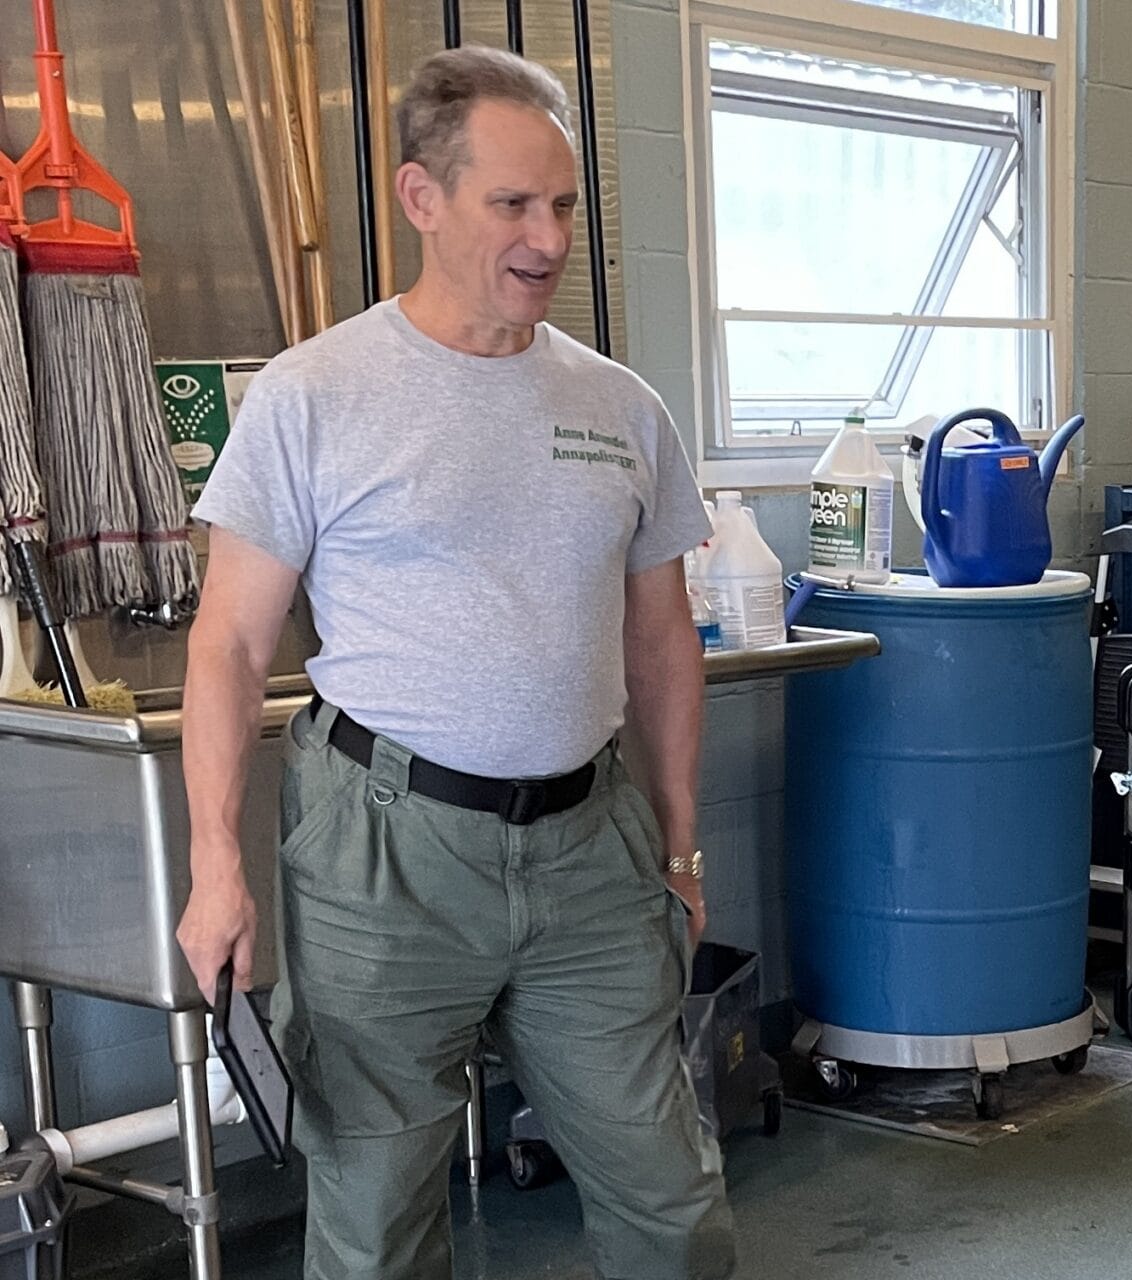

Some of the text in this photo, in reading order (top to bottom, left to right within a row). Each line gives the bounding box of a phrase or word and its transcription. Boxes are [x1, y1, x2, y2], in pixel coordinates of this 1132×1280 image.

[554, 425, 586, 441] Anne
[552, 446, 615, 465] Annapolis
[810, 507, 847, 527] reen
